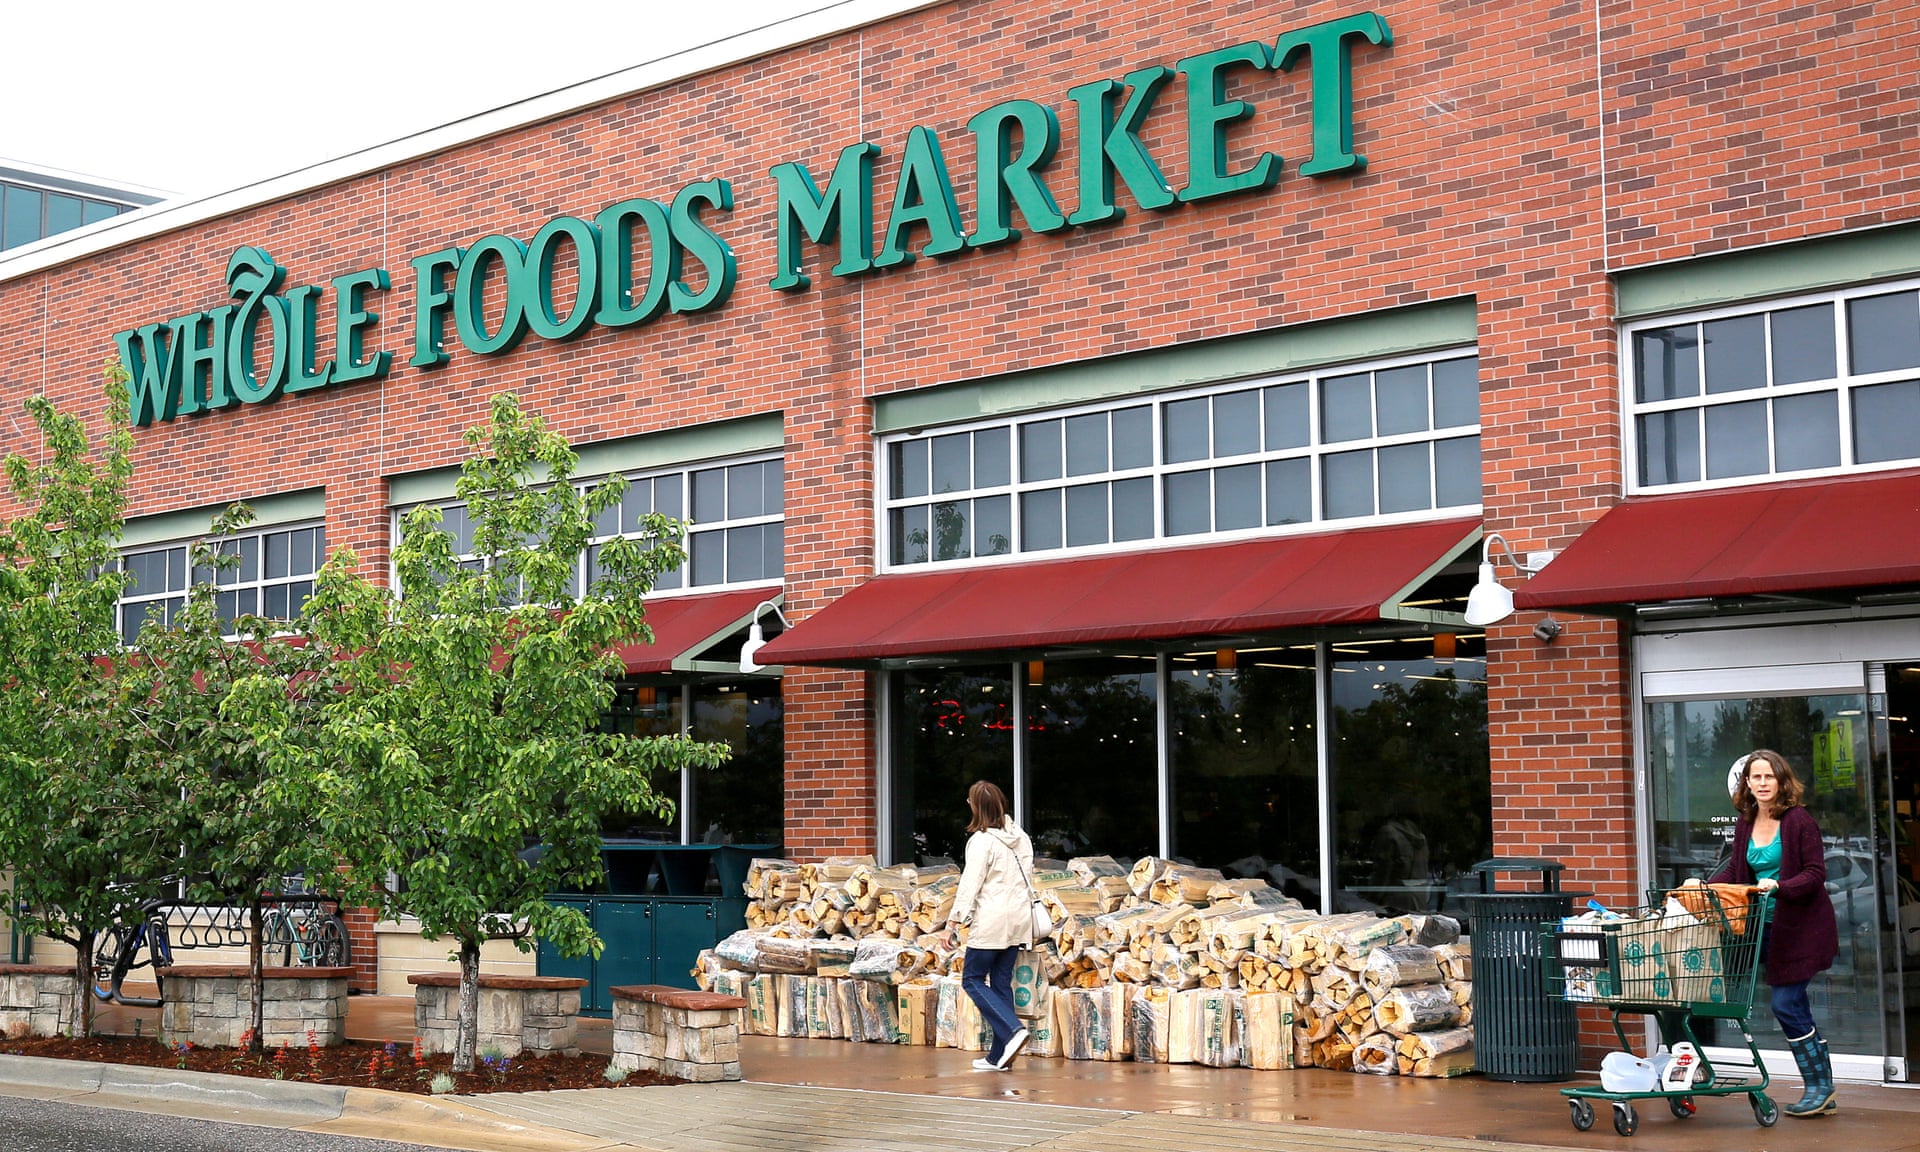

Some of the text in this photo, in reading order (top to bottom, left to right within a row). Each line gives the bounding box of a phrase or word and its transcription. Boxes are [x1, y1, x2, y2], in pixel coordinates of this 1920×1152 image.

[113, 11, 1394, 427] WHOLE FOODS MARKET
